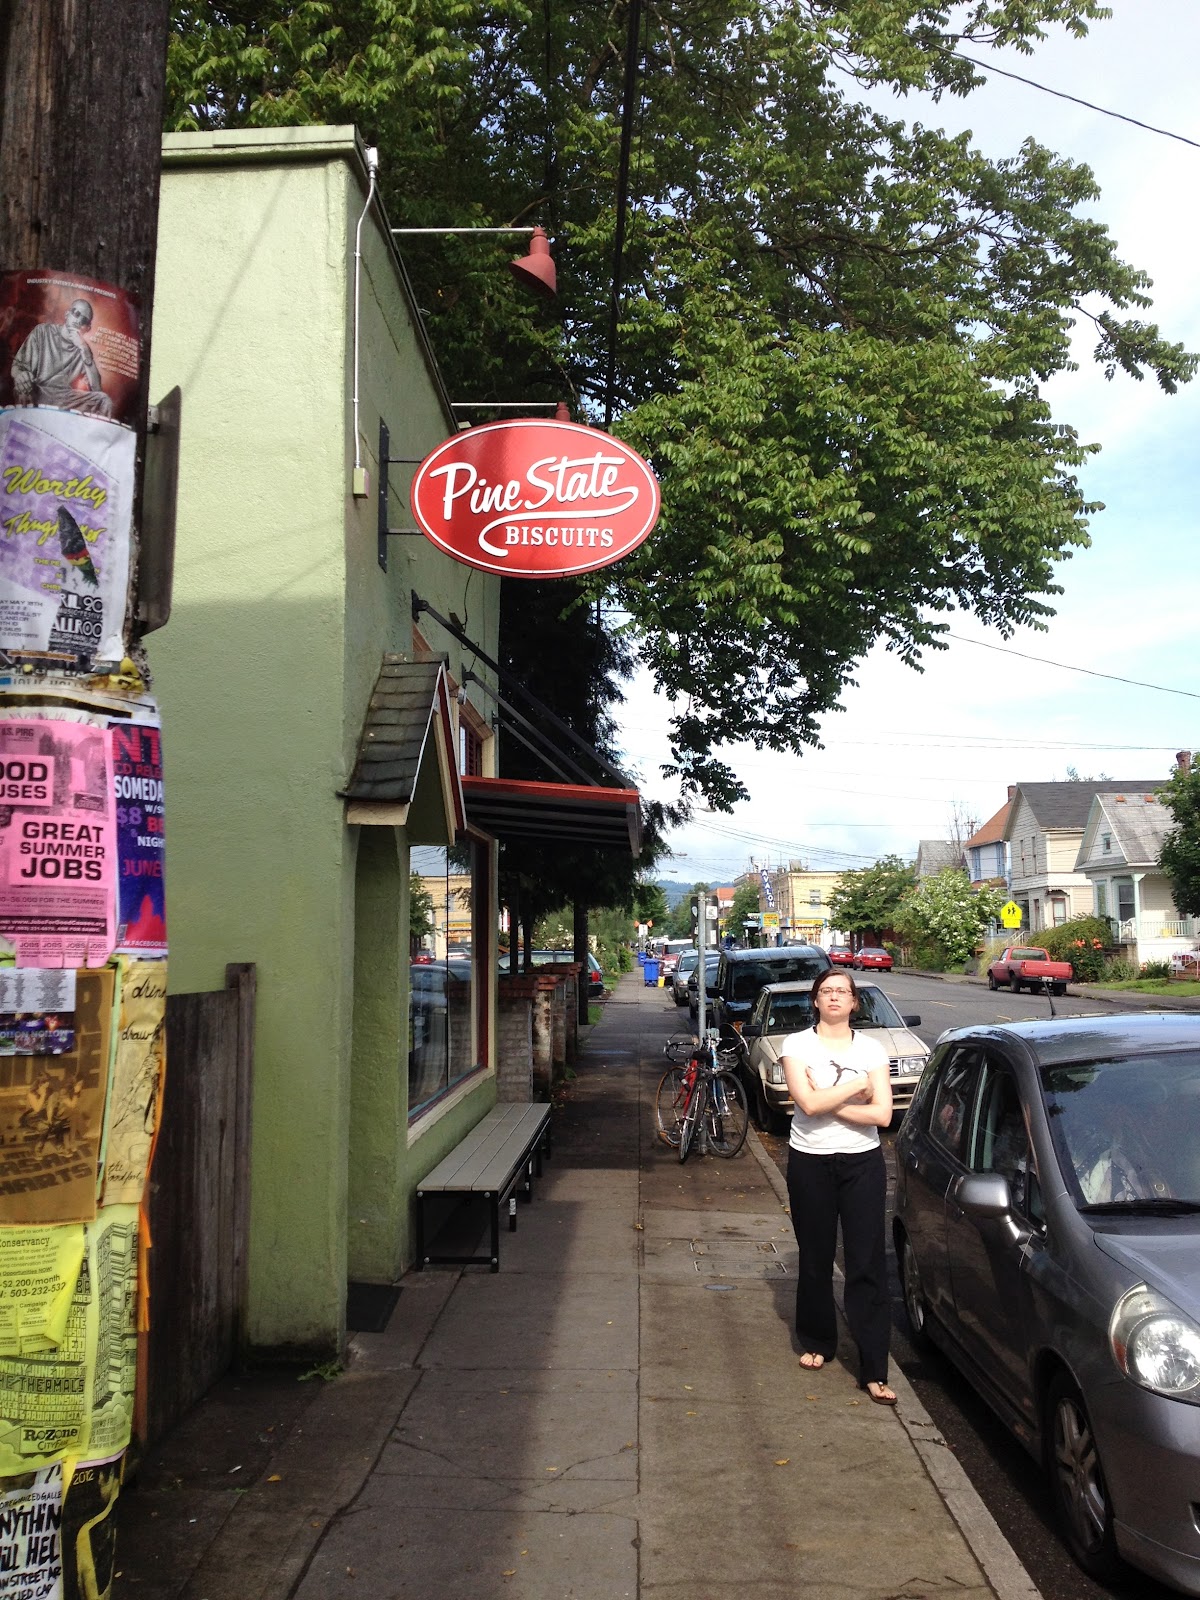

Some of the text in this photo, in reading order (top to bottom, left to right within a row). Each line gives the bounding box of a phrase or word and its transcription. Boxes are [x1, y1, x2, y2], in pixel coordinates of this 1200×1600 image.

[3, 466, 107, 510] Worthy
[429, 452, 639, 520] Pine State
[505, 526, 614, 548] BISCUITS
[116, 805, 142, 828] $8
[22, 821, 104, 843] GREAT
[20, 842, 105, 859] SUMMER
[21, 857, 102, 881] JOBS
[123, 859, 162, 877] JUNE
[761, 870, 775, 908] AVALON
[73, 898, 105, 906] SUMMER
[0, 1237, 51, 1248] onservancy
[20, 1376, 85, 1393] THERMALS
[23, 1428, 78, 1442] RoZone
[72, 1469, 94, 1486] 2012
